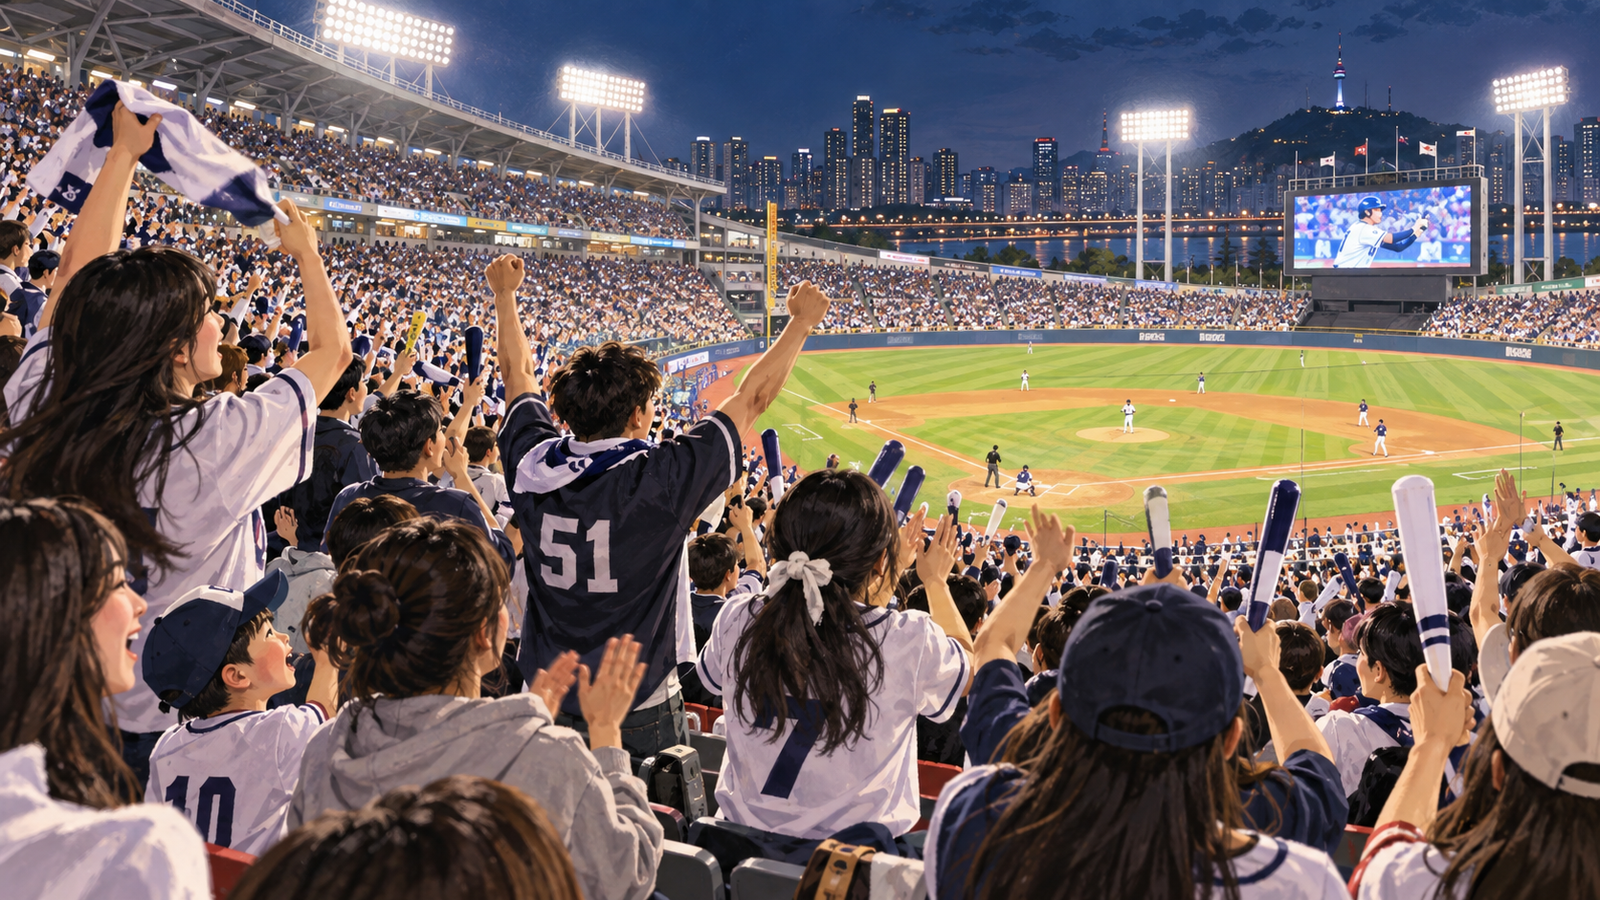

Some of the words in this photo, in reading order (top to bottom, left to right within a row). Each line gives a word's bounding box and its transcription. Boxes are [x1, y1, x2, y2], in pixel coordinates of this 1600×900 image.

[540, 513, 618, 593] 51
[753, 692, 826, 800] 7
[165, 775, 236, 848] 10
